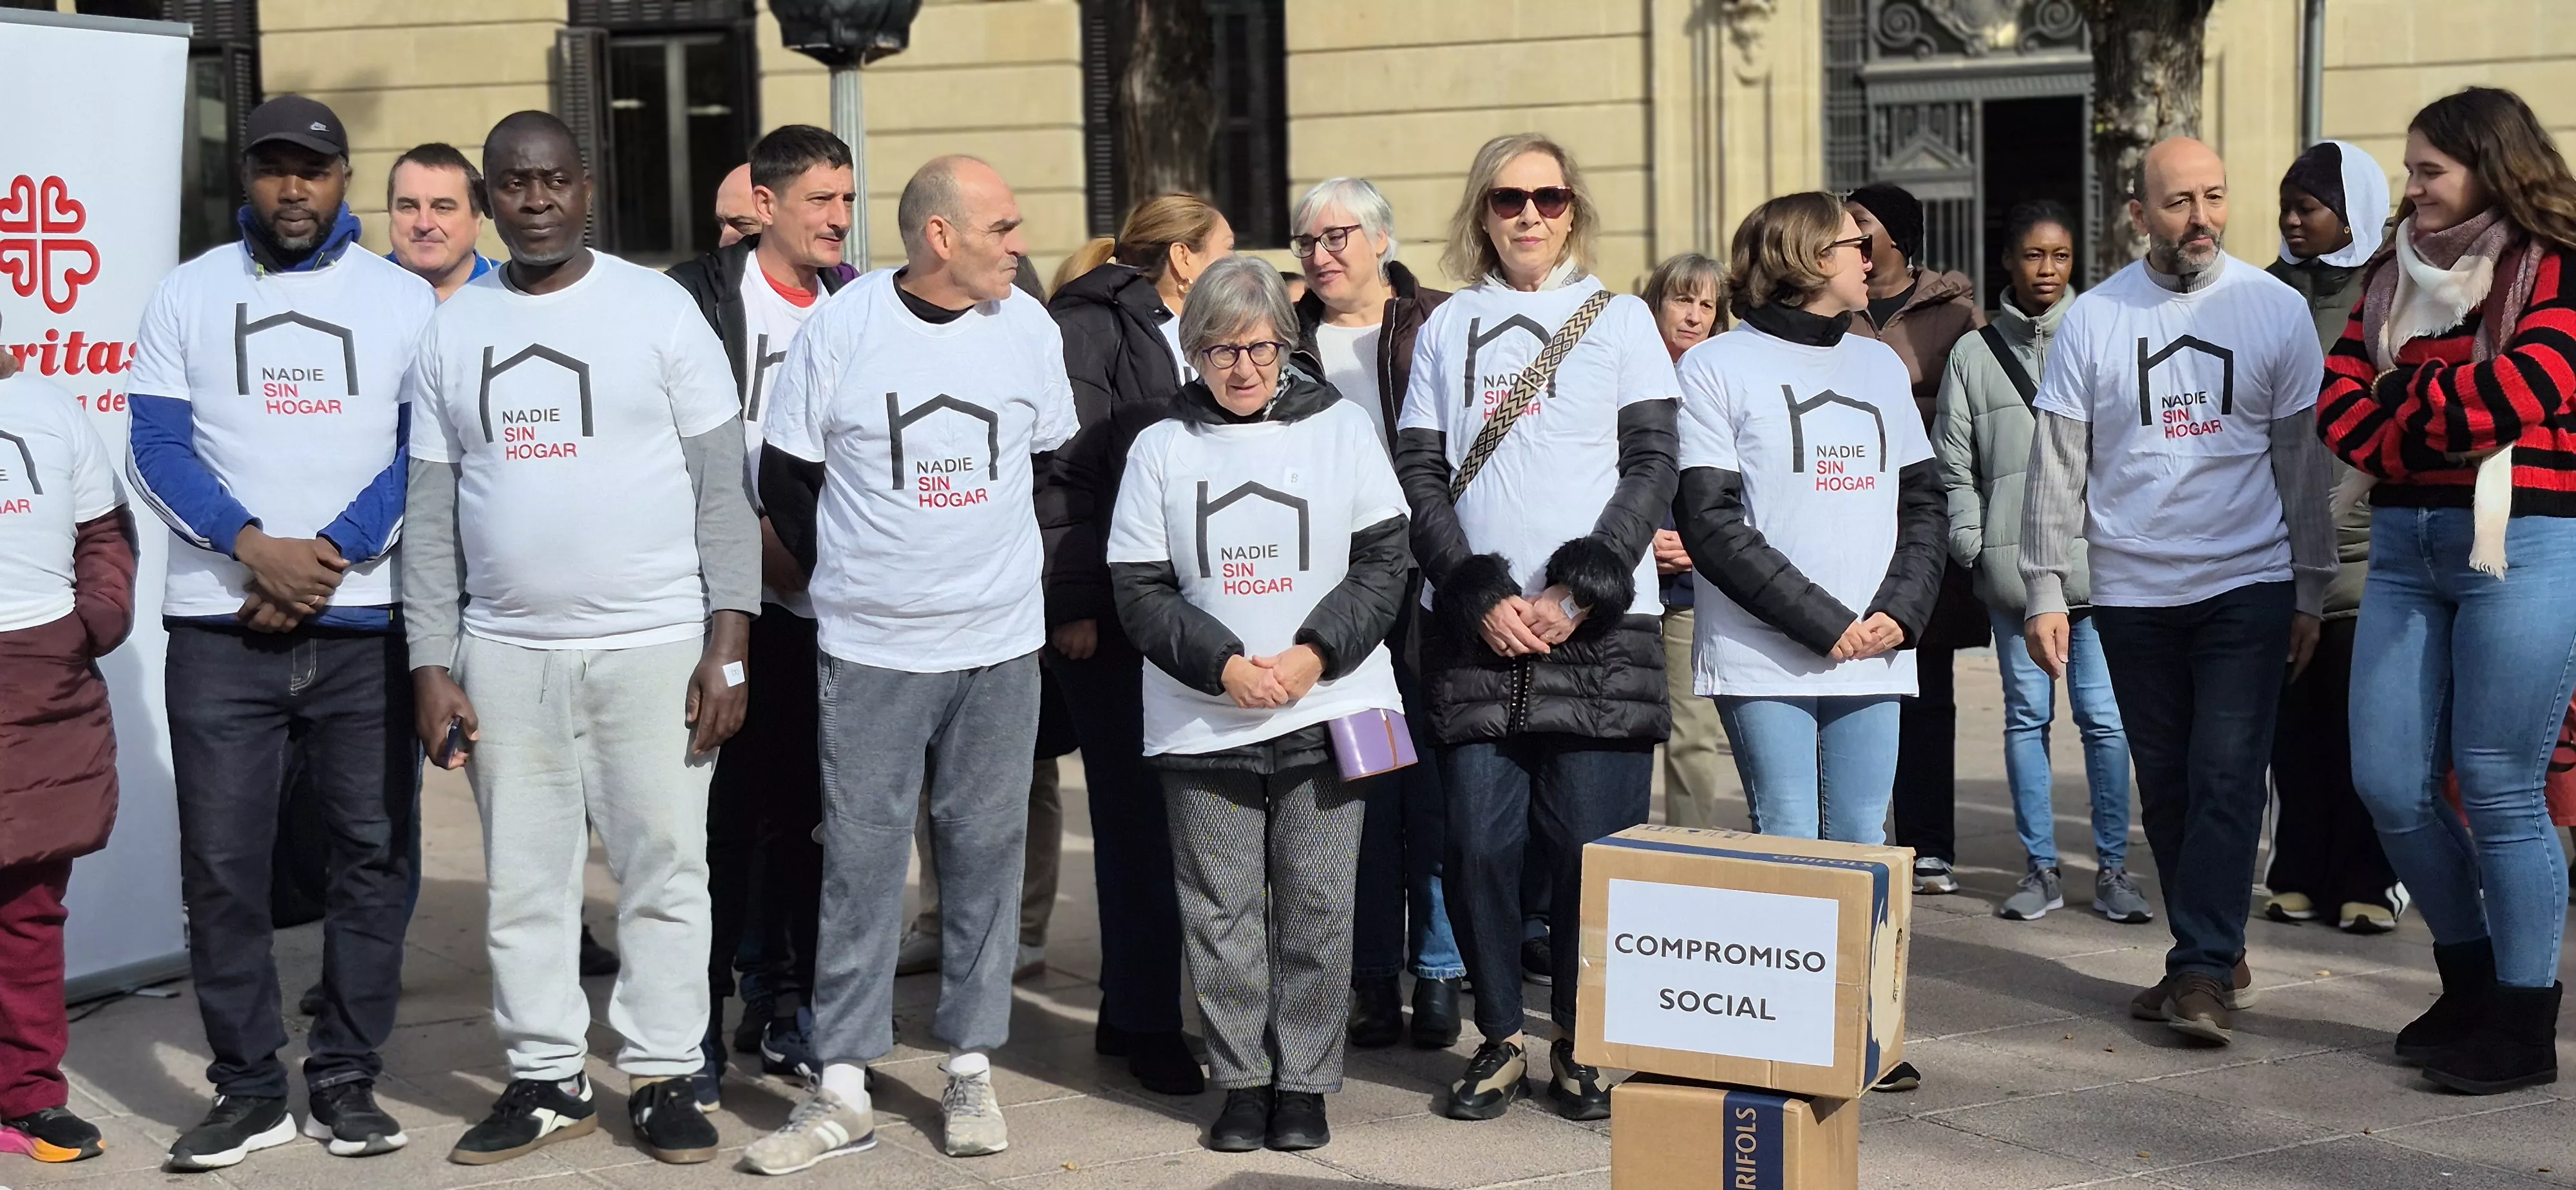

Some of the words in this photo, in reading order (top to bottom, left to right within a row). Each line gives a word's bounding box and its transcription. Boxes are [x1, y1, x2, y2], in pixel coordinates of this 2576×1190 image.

[0, 328, 137, 376] rita
[262, 367, 325, 381] NADIE
[1483, 373, 1520, 388] NAD
[263, 383, 299, 397] SIN
[97, 389, 126, 412] de
[265, 399, 342, 414] HOGAR
[2161, 392, 2207, 408] NADIE
[502, 408, 561, 424] NADIE
[1483, 402, 1541, 420] HAR
[2163, 408, 2190, 424] SIN
[504, 426, 535, 442] SIN
[2164, 420, 2223, 439] HOGAR
[506, 443, 577, 460] HOGAR
[1816, 445, 1866, 458] NADIE
[916, 457, 974, 474] NADIE
[1816, 460, 1844, 475] SIN
[918, 476, 951, 491] SIN
[1815, 476, 1875, 491] HOGAR
[919, 488, 989, 508] HOGAR
[1220, 544, 1278, 561] NADIE
[1222, 562, 1254, 578] SIN
[1224, 578, 1293, 595] HOGAR
[1772, 855, 1875, 867] GRIFOLS
[1615, 933, 1826, 973] COMPROMISO
[1659, 988, 1776, 1021] SOCIAL
[1735, 1107, 1757, 1190] RIFOLS
